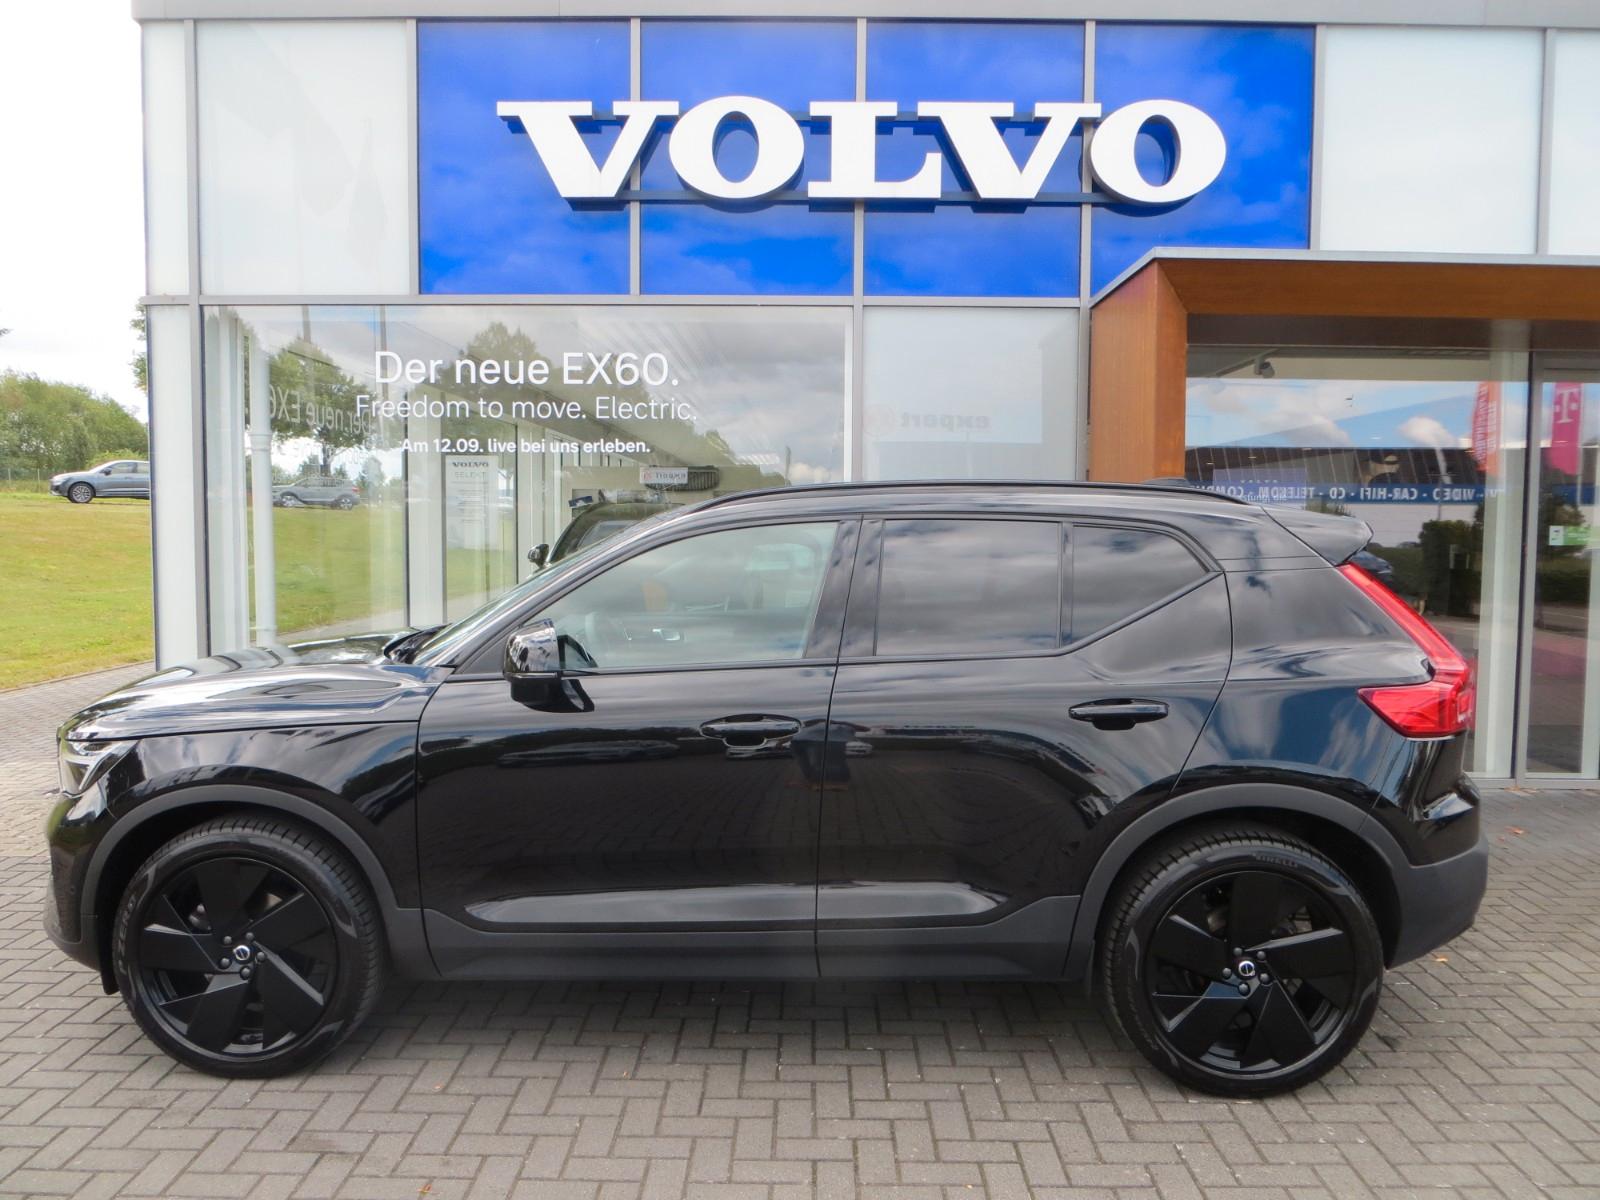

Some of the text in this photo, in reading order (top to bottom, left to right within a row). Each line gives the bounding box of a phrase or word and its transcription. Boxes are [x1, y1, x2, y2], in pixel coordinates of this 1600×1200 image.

[497, 96, 1226, 202] VOLVO
[375, 351, 679, 386] Der neue EX60.
[356, 395, 697, 420] Freedom to move. Electric.
[401, 438, 650, 454] Am 12.09. live bei uns erleben.
